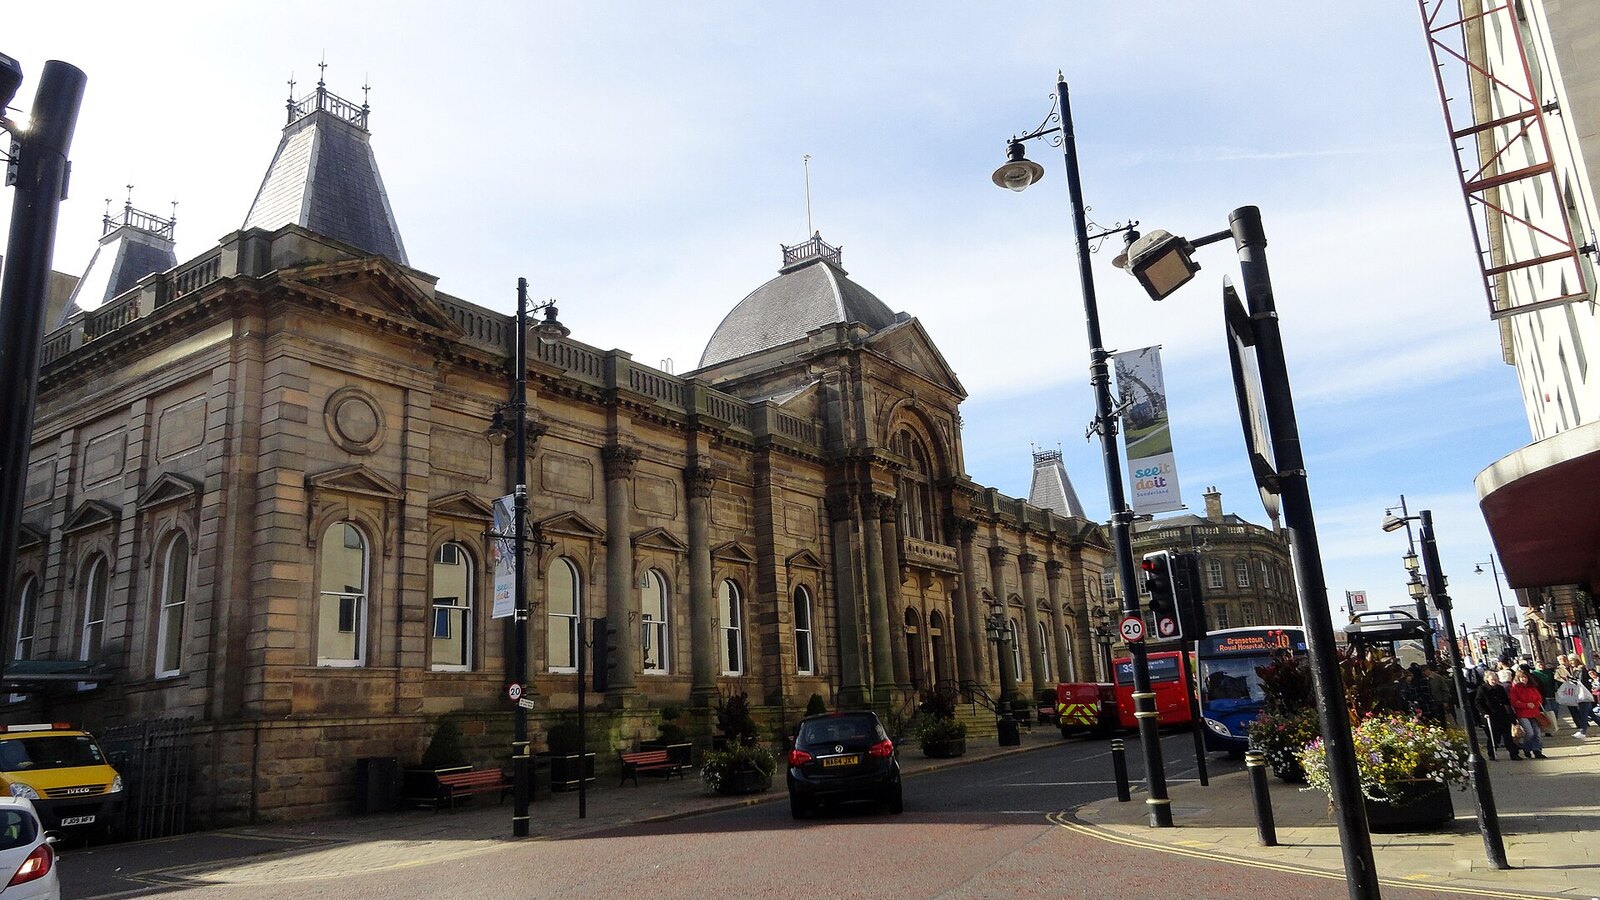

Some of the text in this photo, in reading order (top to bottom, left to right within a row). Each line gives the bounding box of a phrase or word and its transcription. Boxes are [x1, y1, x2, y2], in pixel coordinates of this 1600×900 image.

[1136, 489, 1169, 497] Sunderland
[1123, 624, 1141, 635] 20
[1219, 644, 1237, 652] Royal
